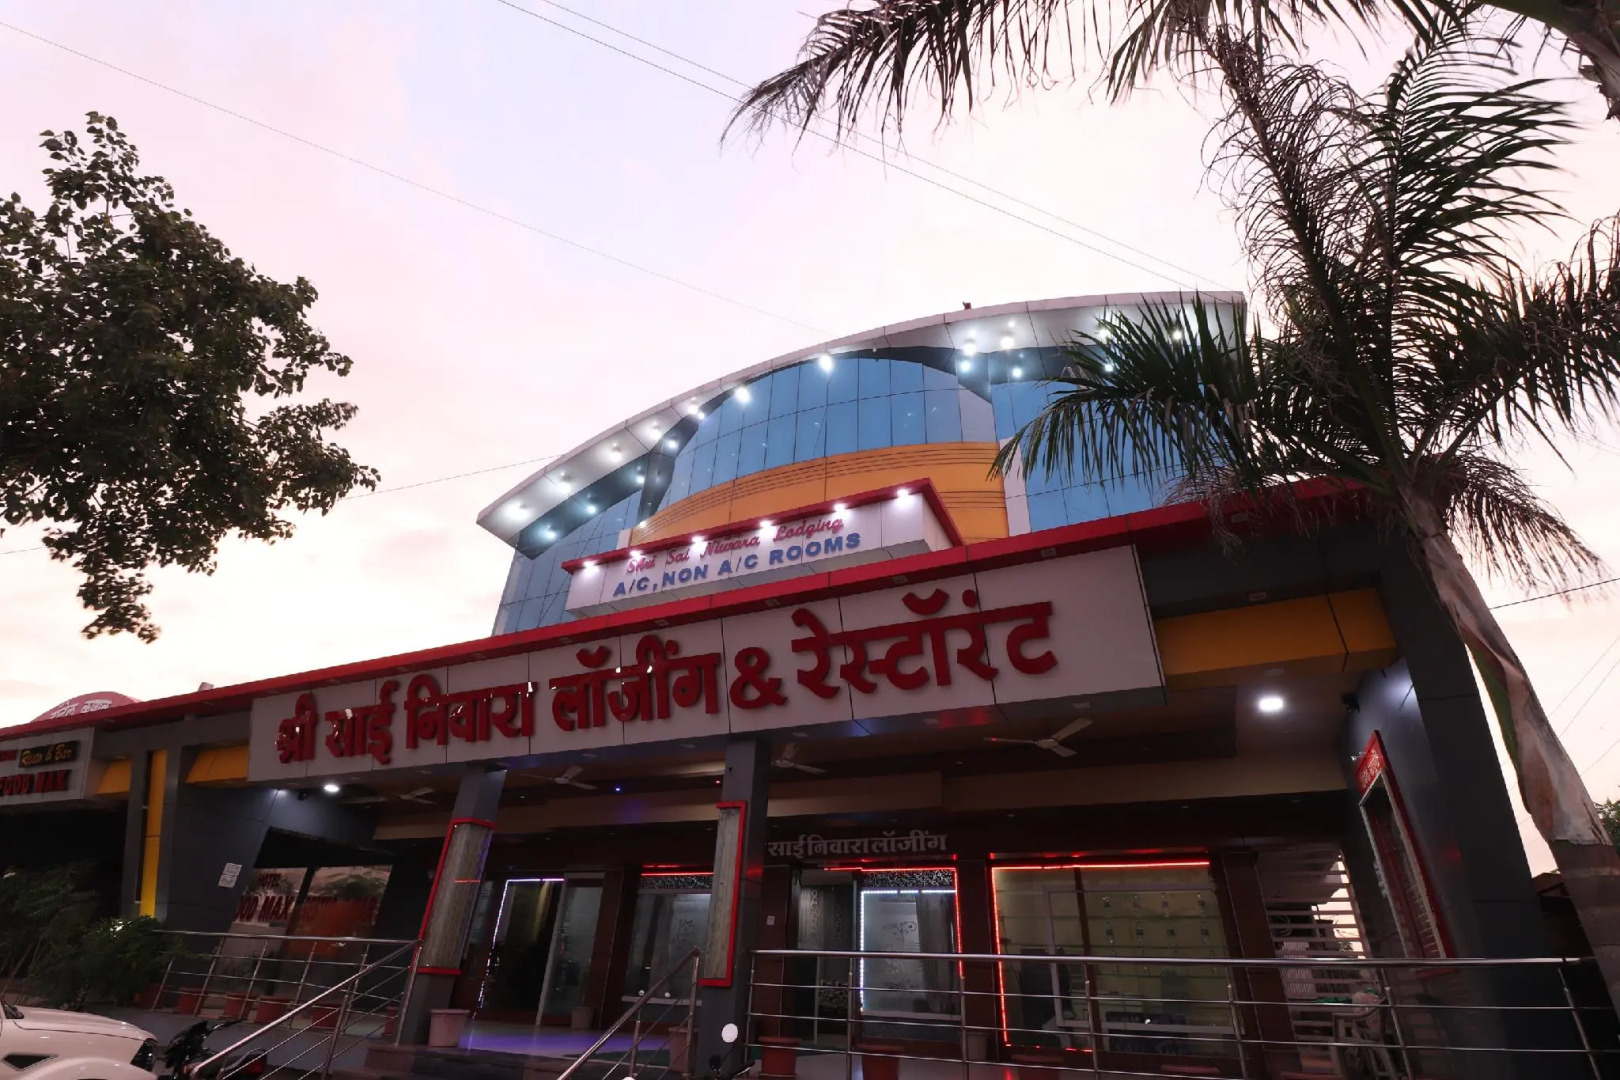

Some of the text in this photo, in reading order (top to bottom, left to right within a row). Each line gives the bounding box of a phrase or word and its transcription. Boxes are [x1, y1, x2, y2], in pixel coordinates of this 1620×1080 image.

[666, 547, 690, 565] Sai
[773, 517, 844, 542] Lodging
[717, 554, 758, 575] A/C
[769, 532, 861, 565] ROOMS
[275, 588, 1057, 765] श्री साई निवारा लॉजींग & रेस्टॉरंट
[35, 770, 70, 793] MAX
[257, 895, 295, 922] MAX
